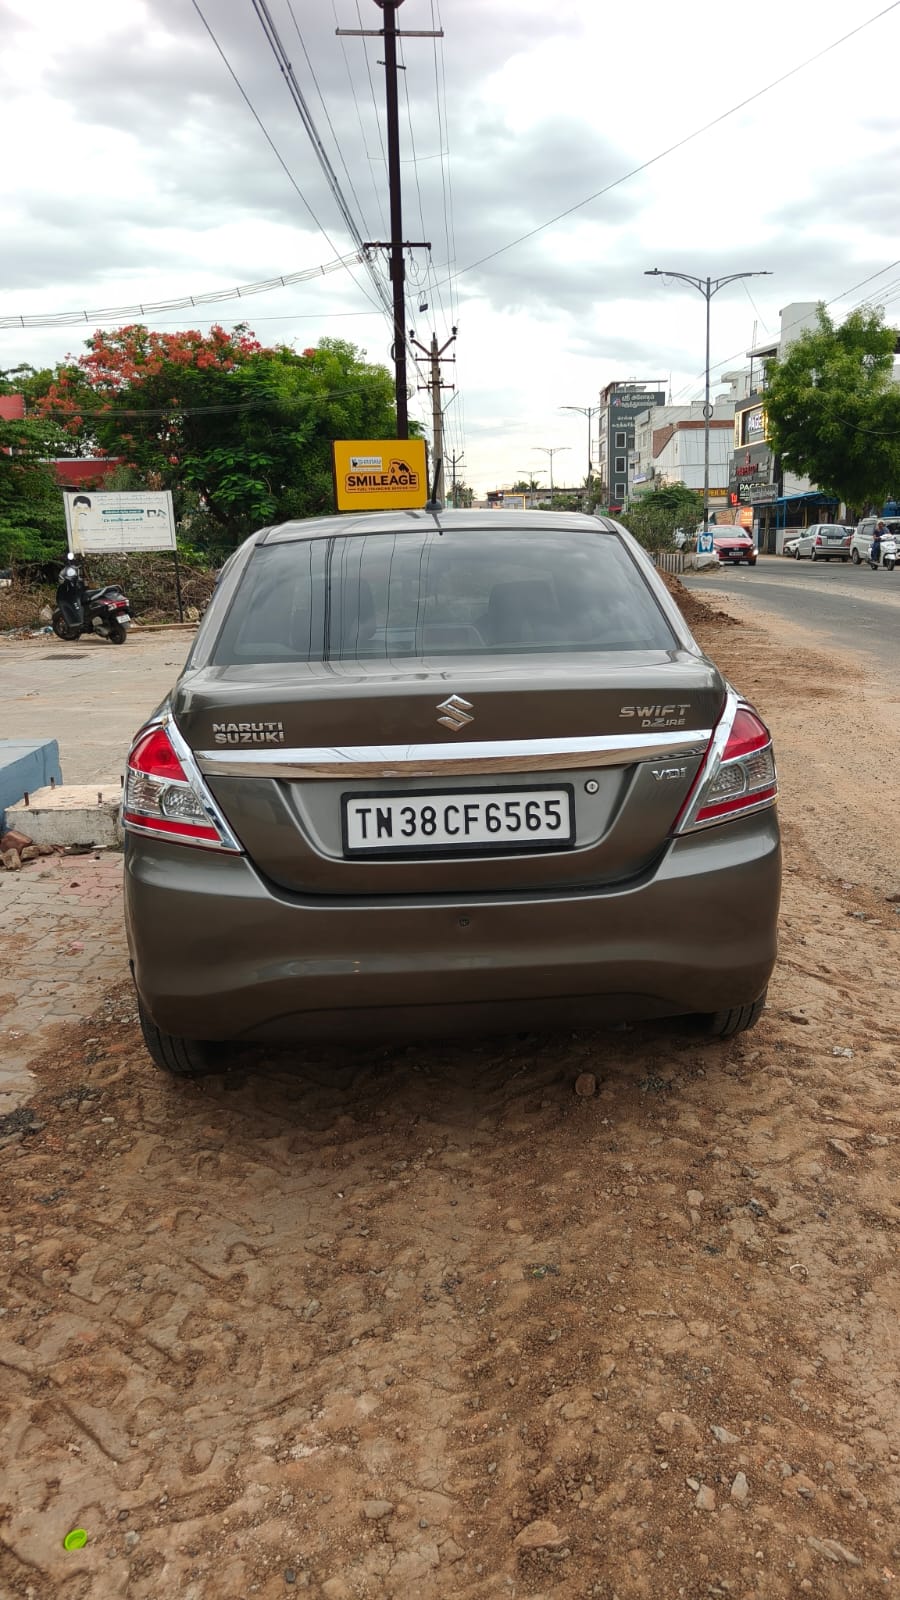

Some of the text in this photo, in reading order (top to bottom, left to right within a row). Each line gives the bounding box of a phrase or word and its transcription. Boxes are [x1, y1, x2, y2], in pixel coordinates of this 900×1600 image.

[347, 474, 417, 487] SMILEAGE
[618, 704, 691, 718] SWIFT
[212, 721, 283, 733] MARUTI
[214, 731, 285, 744] SUZUKI
